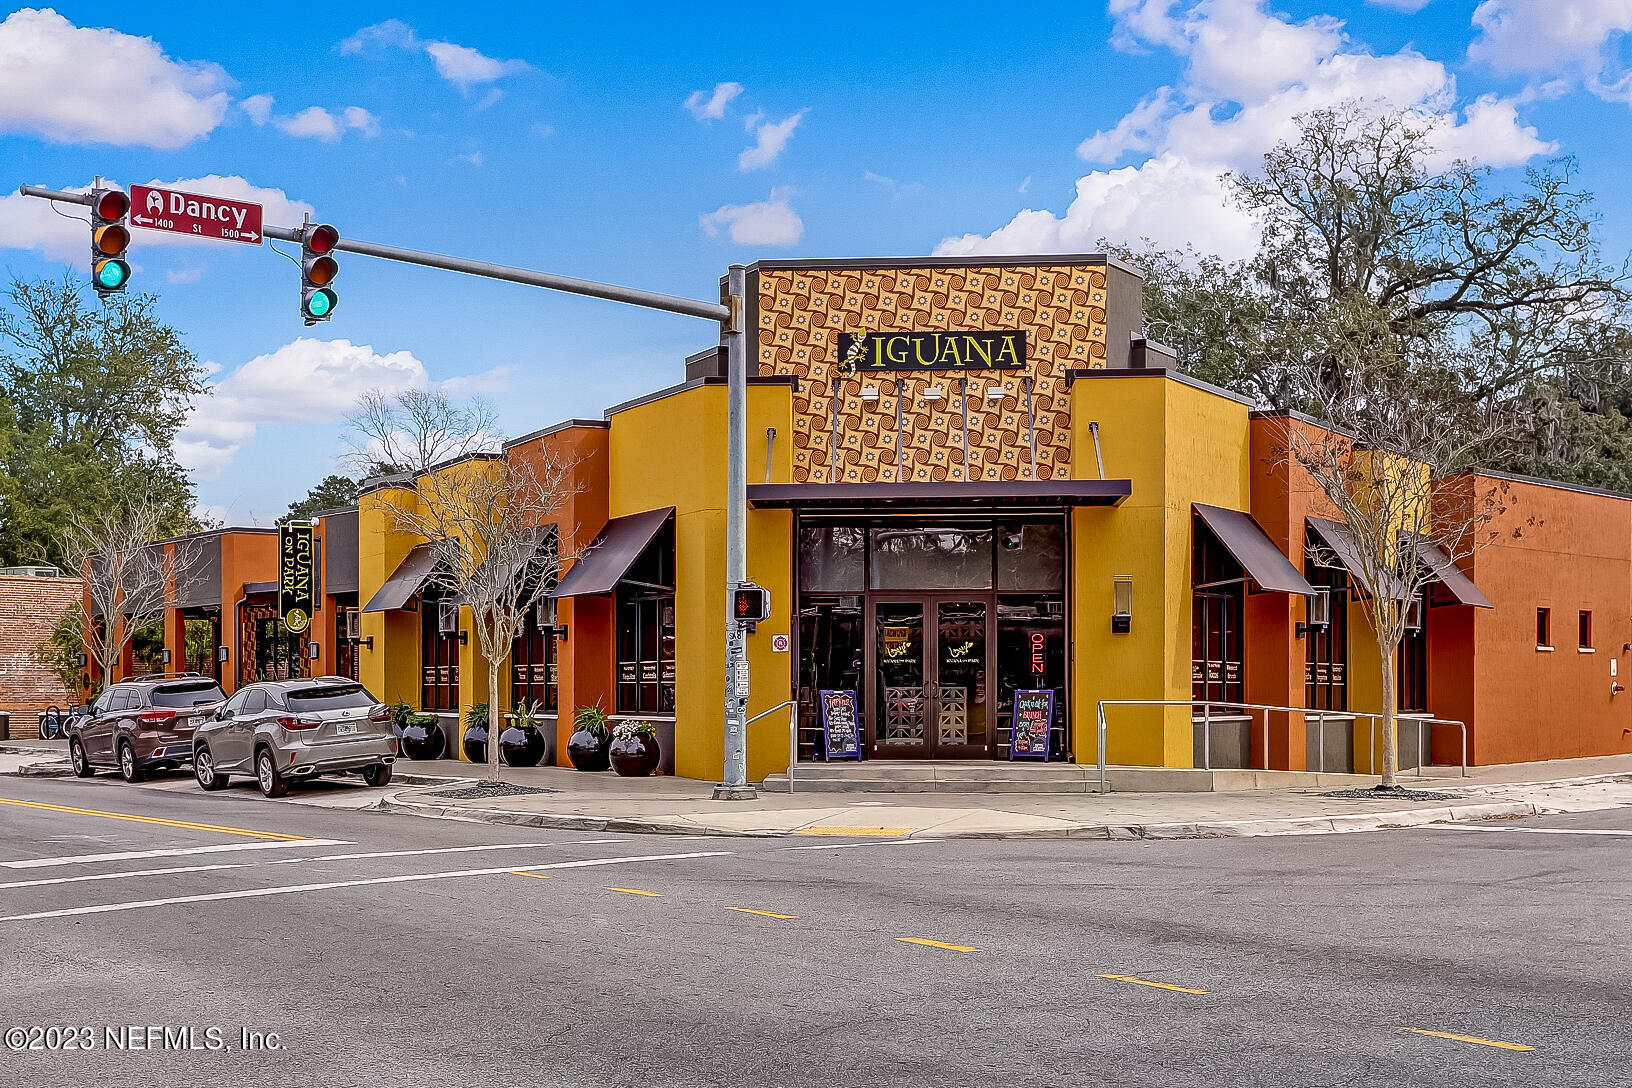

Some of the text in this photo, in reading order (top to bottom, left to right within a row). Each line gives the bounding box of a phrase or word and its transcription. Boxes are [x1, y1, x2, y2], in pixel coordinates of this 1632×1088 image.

[154, 218, 174, 229] 1400
[170, 192, 247, 229] Dancy
[192, 223, 203, 234] St
[221, 228, 240, 239] 1500
[870, 333, 1022, 368] IGUANA
[282, 536, 295, 595] ON PARK
[295, 532, 312, 602] IGUANA
[1031, 633, 1044, 673] OPEN
